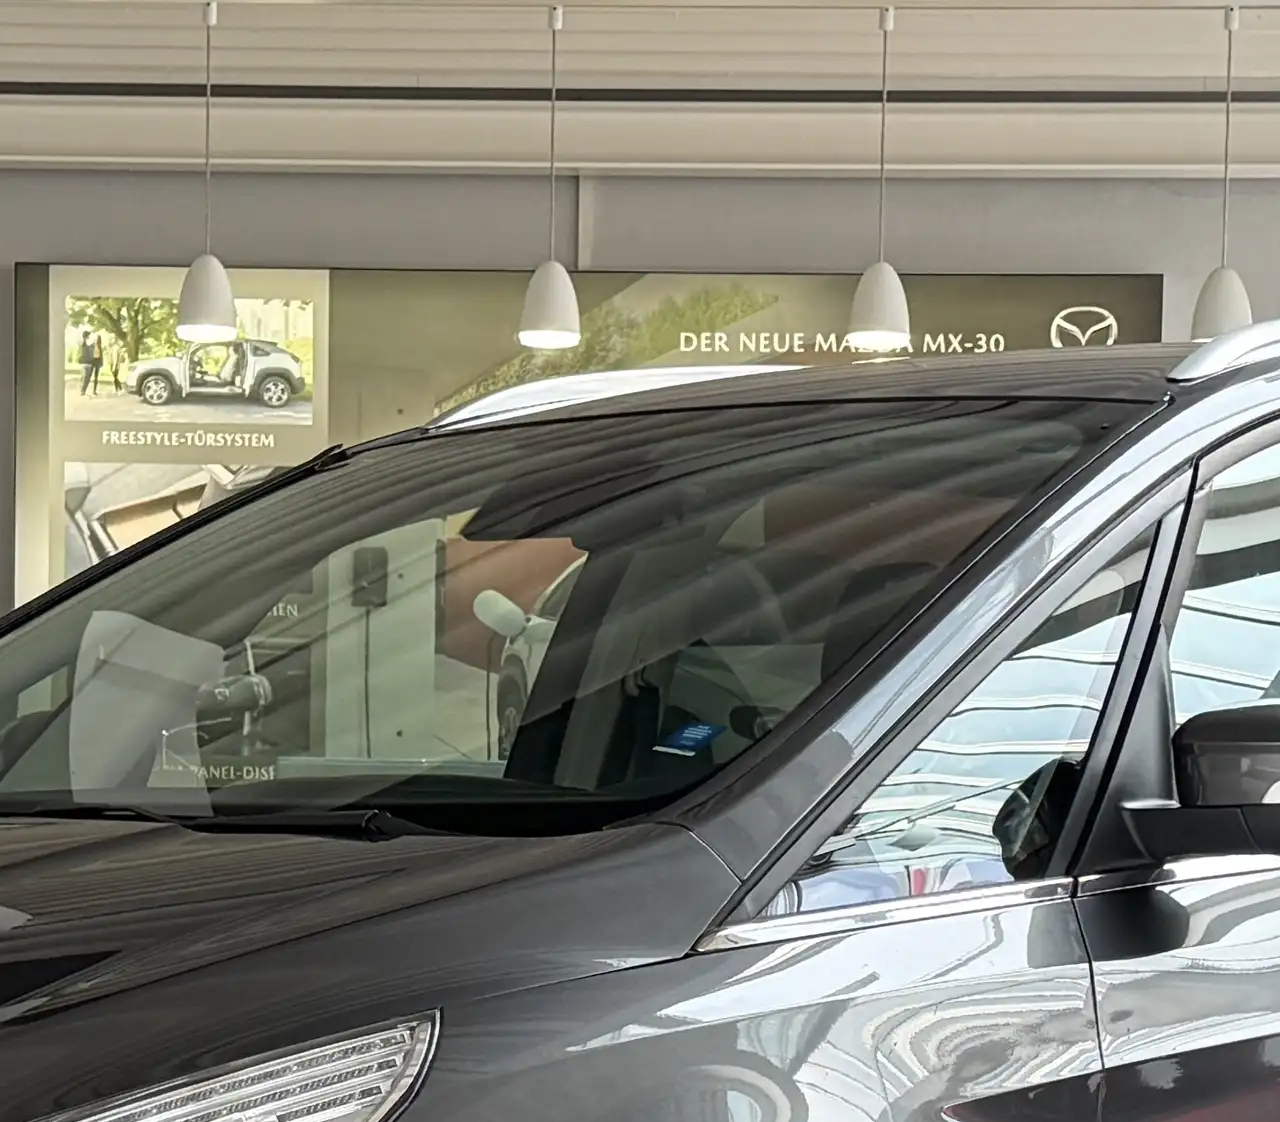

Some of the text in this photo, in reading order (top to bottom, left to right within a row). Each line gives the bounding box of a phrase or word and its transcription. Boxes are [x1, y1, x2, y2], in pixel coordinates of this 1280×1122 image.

[679, 332, 730, 352] DER
[739, 333, 805, 353] NEUE
[922, 333, 1005, 353] MX-30
[102, 429, 275, 447] FREESTYLE-TÜRSYSTEM
